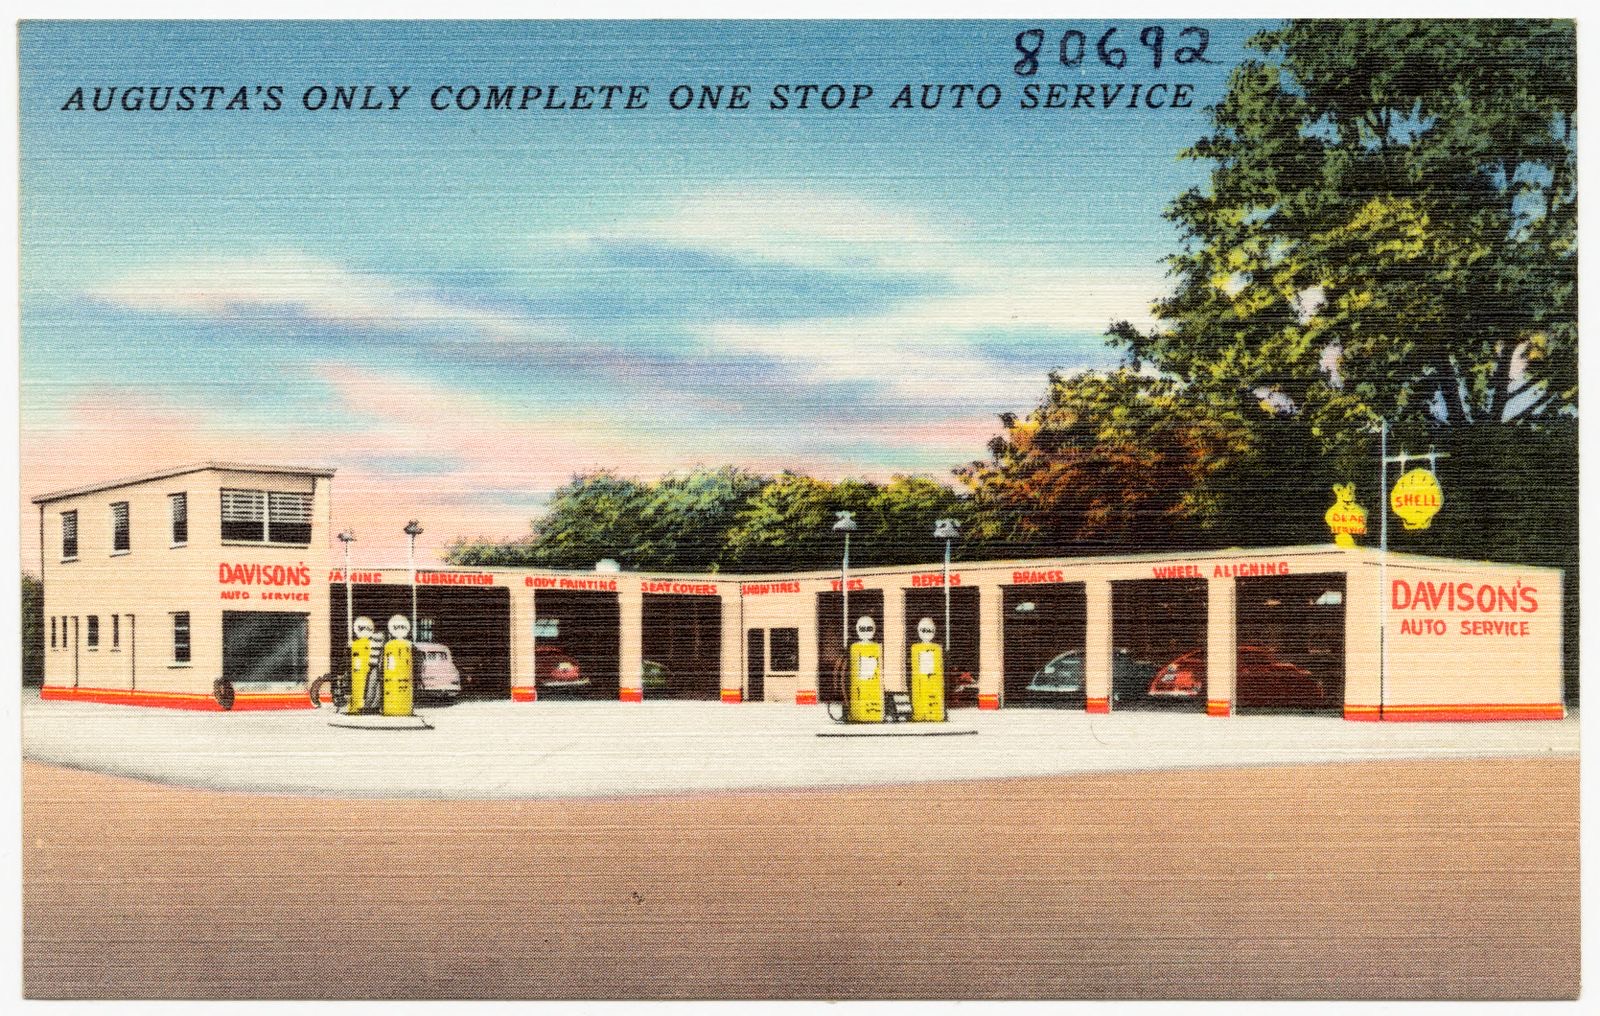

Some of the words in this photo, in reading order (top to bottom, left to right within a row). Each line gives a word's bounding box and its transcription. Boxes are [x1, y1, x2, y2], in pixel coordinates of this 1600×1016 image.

[1014, 25, 1222, 77] 80692
[1394, 494, 1440, 508] SHELL
[219, 561, 311, 587] DAVISON'S
[1012, 570, 1065, 585] BRAKES
[1152, 565, 1203, 580] WHEEL
[1213, 561, 1290, 578] ALIGNING
[415, 571, 494, 586] LUBRICATION
[524, 576, 556, 588] BODY
[560, 578, 617, 591] PAINTING
[640, 581, 670, 593] SEAT
[672, 583, 718, 595] COVERS
[1391, 576, 1539, 613] DAVISON'S
[220, 590, 249, 600] AUTO
[261, 591, 310, 602] SERVICE
[1401, 619, 1448, 636] AUTO
[1460, 620, 1530, 637] SERVICE
